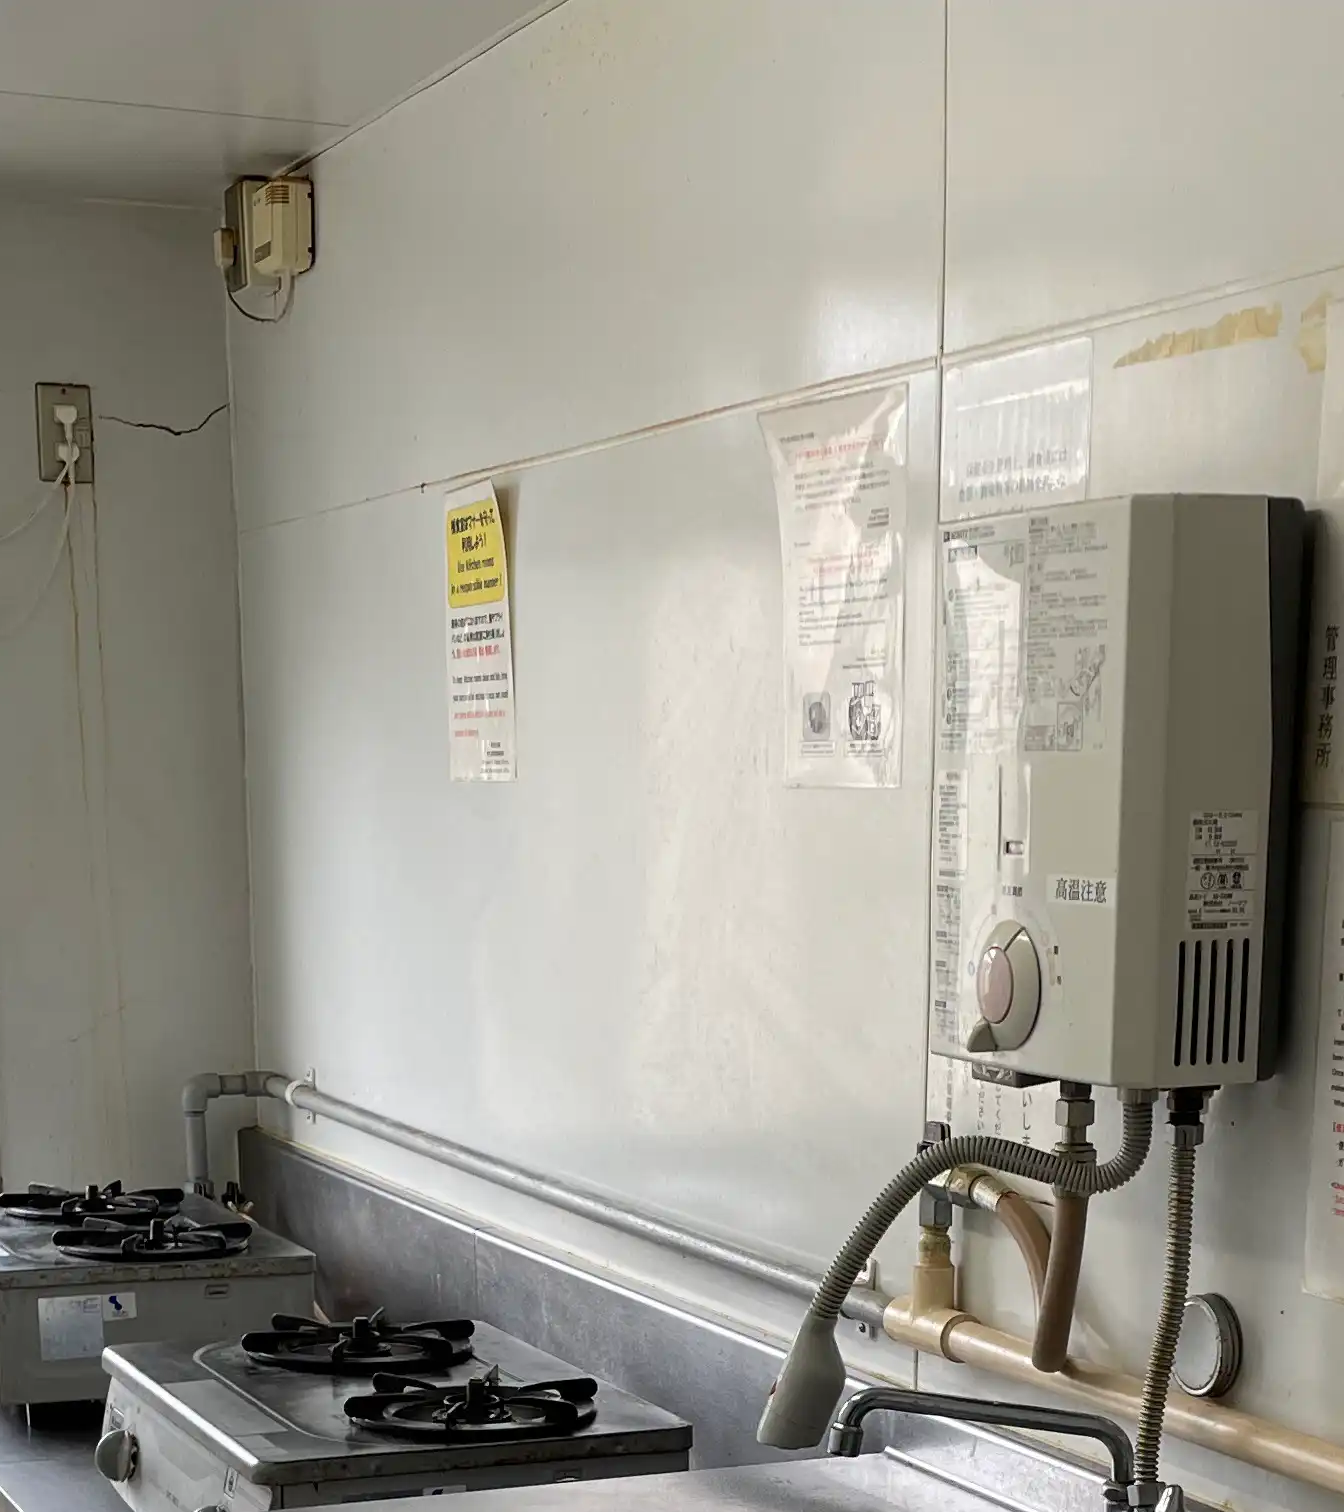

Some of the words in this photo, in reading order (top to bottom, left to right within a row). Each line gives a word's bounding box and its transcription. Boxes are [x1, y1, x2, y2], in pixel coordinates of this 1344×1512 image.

[1314, 625, 1340, 768] 管理事務所
[1055, 878, 1107, 904] 高温注意
